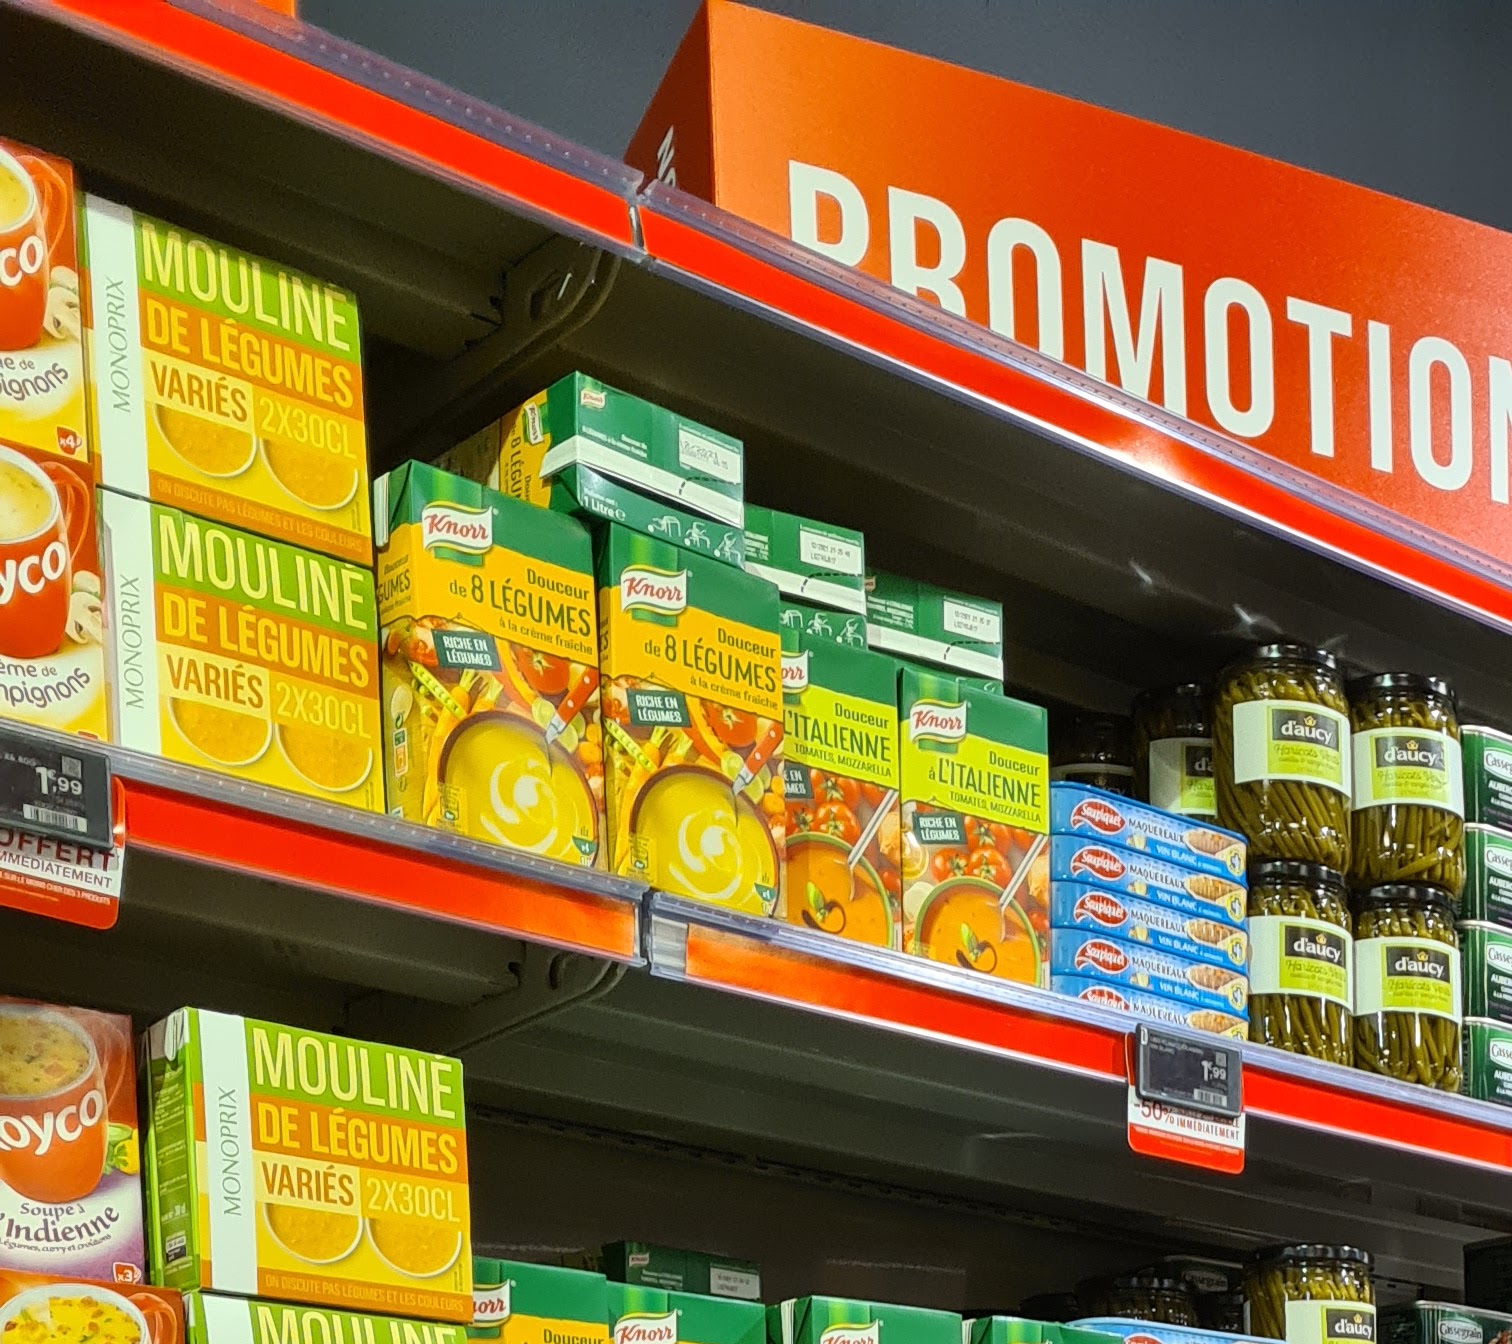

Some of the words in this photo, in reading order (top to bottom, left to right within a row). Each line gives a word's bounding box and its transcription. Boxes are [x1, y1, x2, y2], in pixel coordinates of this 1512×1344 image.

[105, 277, 131, 413] MONOPRIX
[146, 298, 190, 353] DE
[200, 318, 354, 408] LÉGUMES
[151, 361, 248, 423] VARIÉS
[259, 398, 358, 459] 2X30CL
[425, 513, 488, 541] Knorr
[159, 515, 367, 630] MOULINÉ
[450, 580, 467, 598] de
[471, 575, 484, 604] 8
[490, 578, 591, 637] LÉGUMES
[526, 568, 589, 600] Douceur
[120, 575, 145, 710] MONOPRIX
[163, 592, 207, 643] DE
[219, 605, 369, 688] LÉGUMES
[442, 635, 470, 650] RICHE
[474, 638, 488, 652] EN
[166, 654, 264, 709] VARIÉS
[275, 681, 372, 739] 2X30CL
[1281, 720, 1334, 745] d'aucy
[253, 1028, 456, 1119] MOULINÉ
[0, 1090, 101, 1155] oyco
[222, 1086, 242, 1217] MONOPRIX
[258, 1102, 299, 1149] DE
[311, 1106, 458, 1176] LÉGUMES
[262, 1160, 355, 1206] VARIÉS
[367, 1178, 461, 1222] 2X30CL
